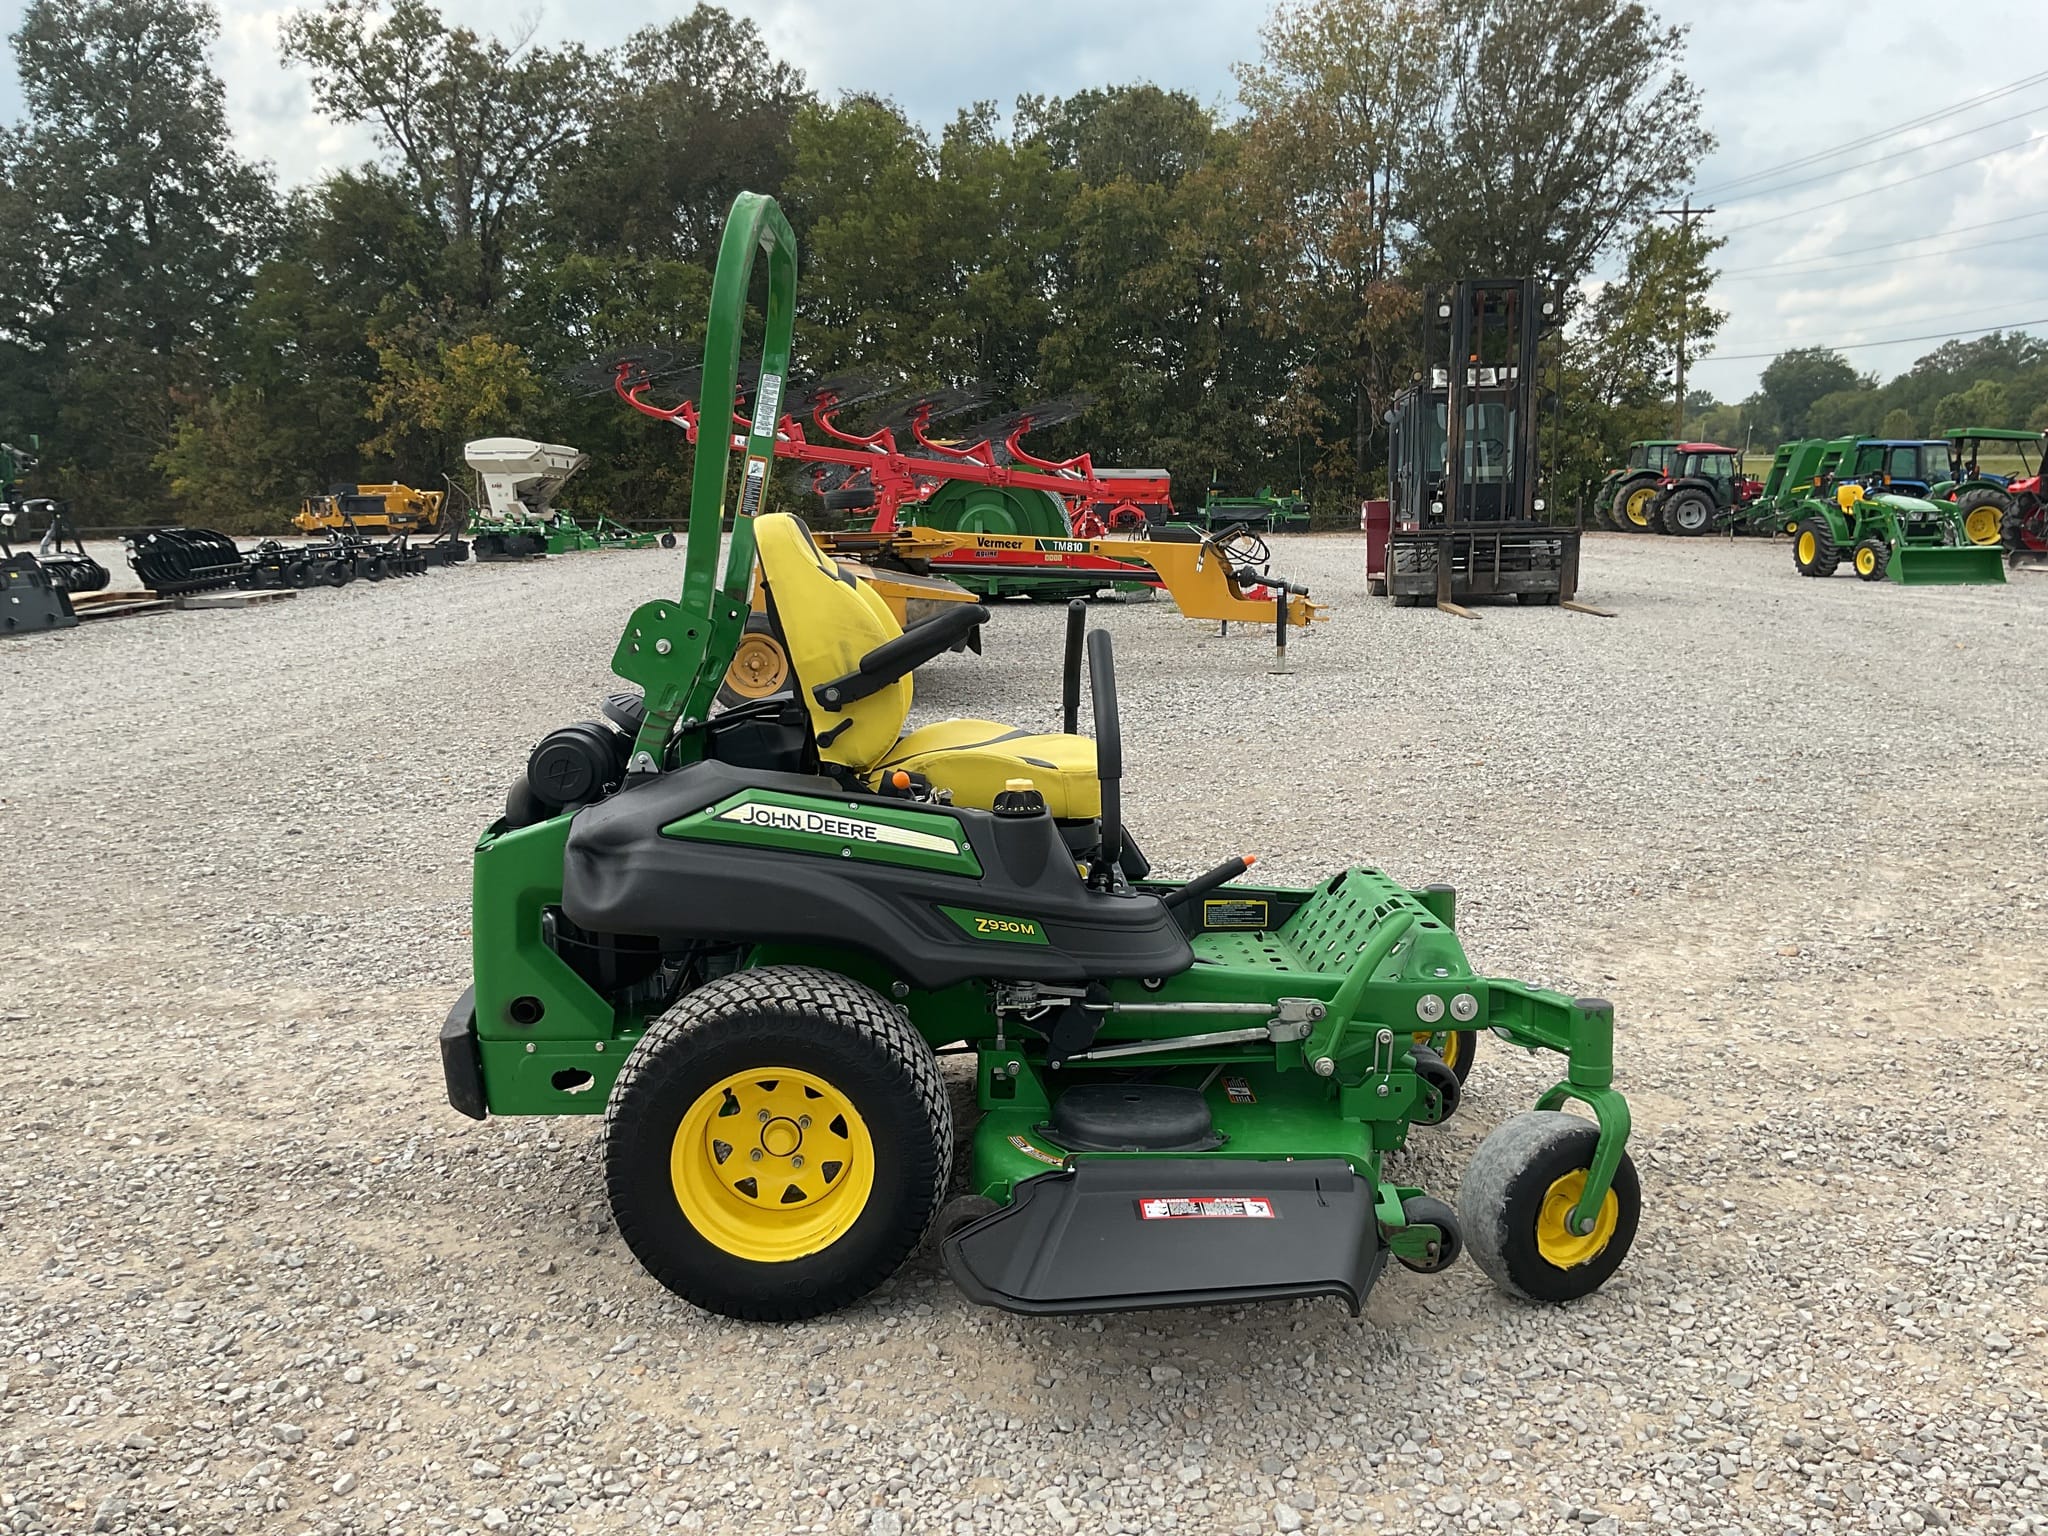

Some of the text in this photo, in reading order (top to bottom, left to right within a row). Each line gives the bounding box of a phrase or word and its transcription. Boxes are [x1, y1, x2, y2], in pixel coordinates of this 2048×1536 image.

[977, 537, 1023, 549] Vermeer
[1052, 540, 1083, 552] TM810
[743, 806, 877, 839] JOHN DEERE
[975, 918, 1035, 935] Z930M
